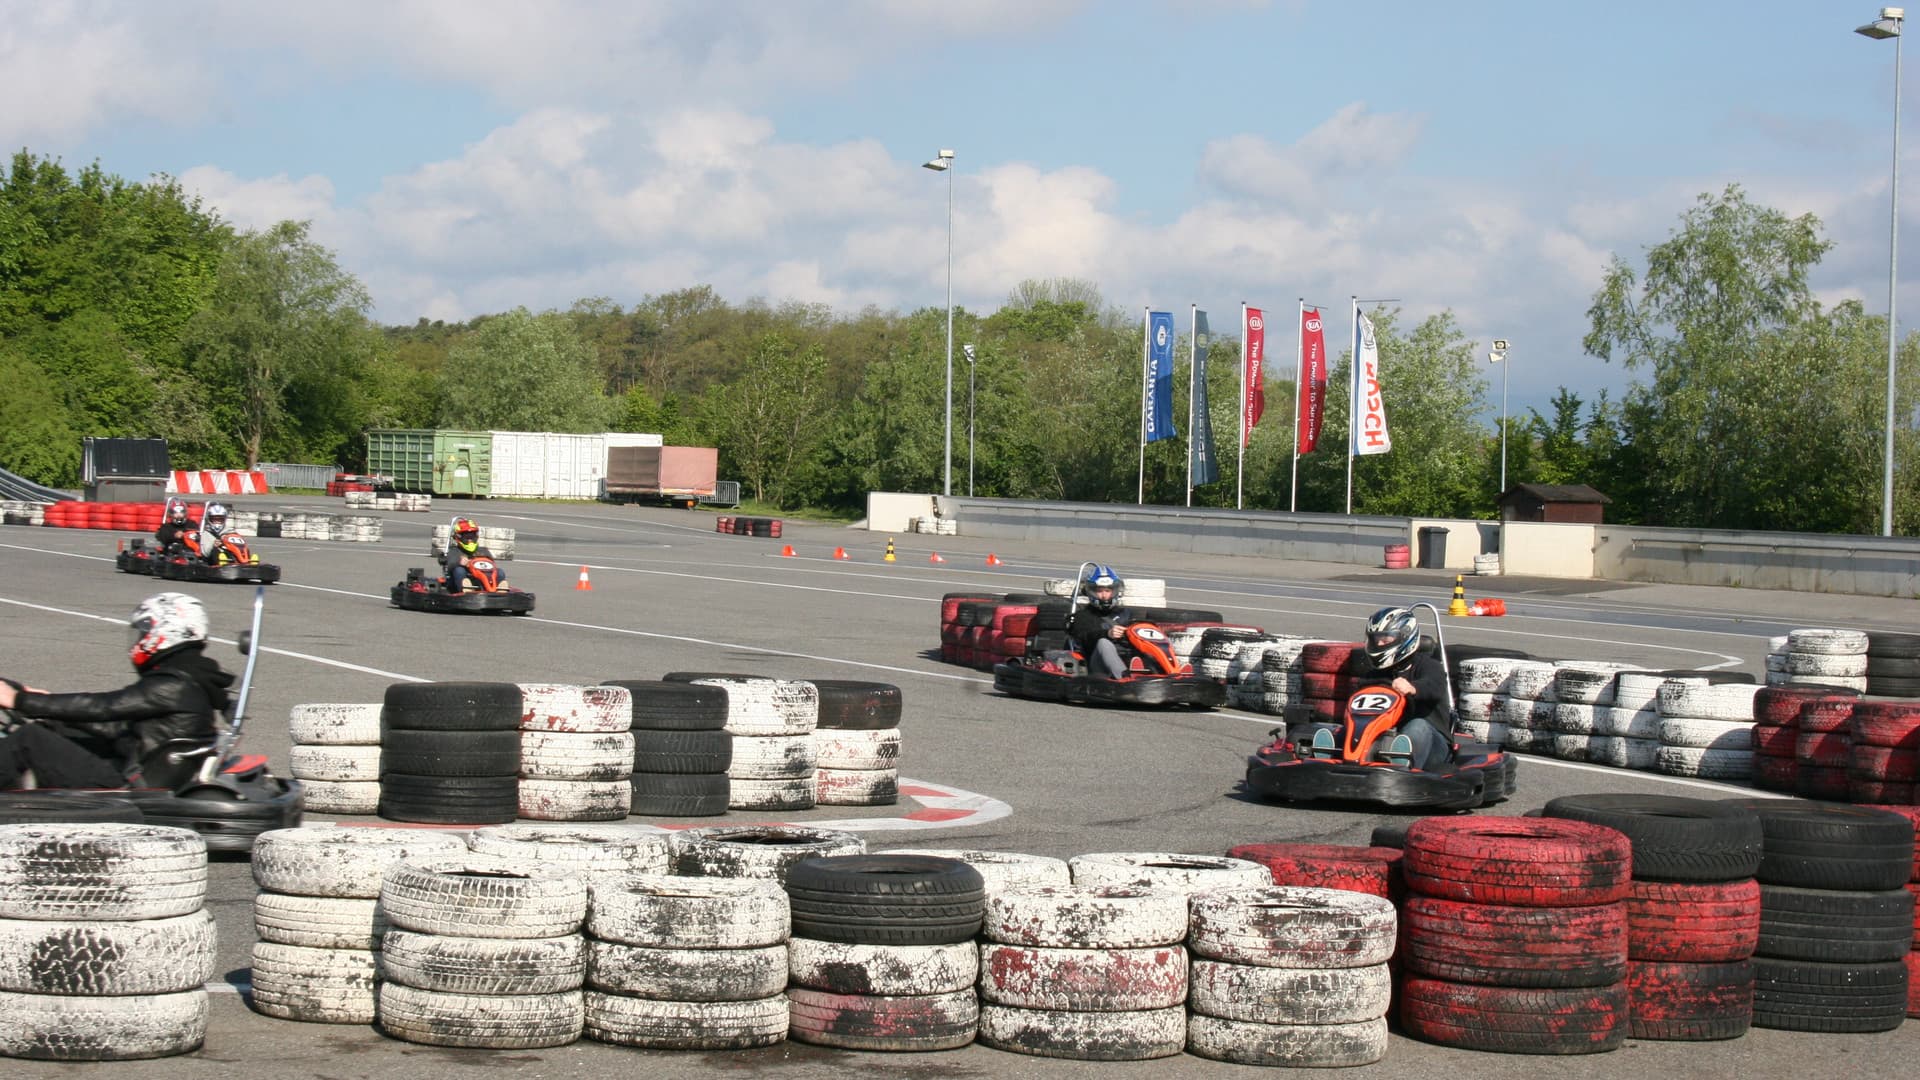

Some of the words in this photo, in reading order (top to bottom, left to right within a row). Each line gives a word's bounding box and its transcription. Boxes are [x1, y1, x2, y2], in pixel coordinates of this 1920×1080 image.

[1251, 341, 1259, 358] The
[1147, 359, 1158, 433] GARANTA
[1310, 392, 1316, 402] to
[1143, 630, 1154, 638] 7
[1354, 696, 1388, 710] 12
